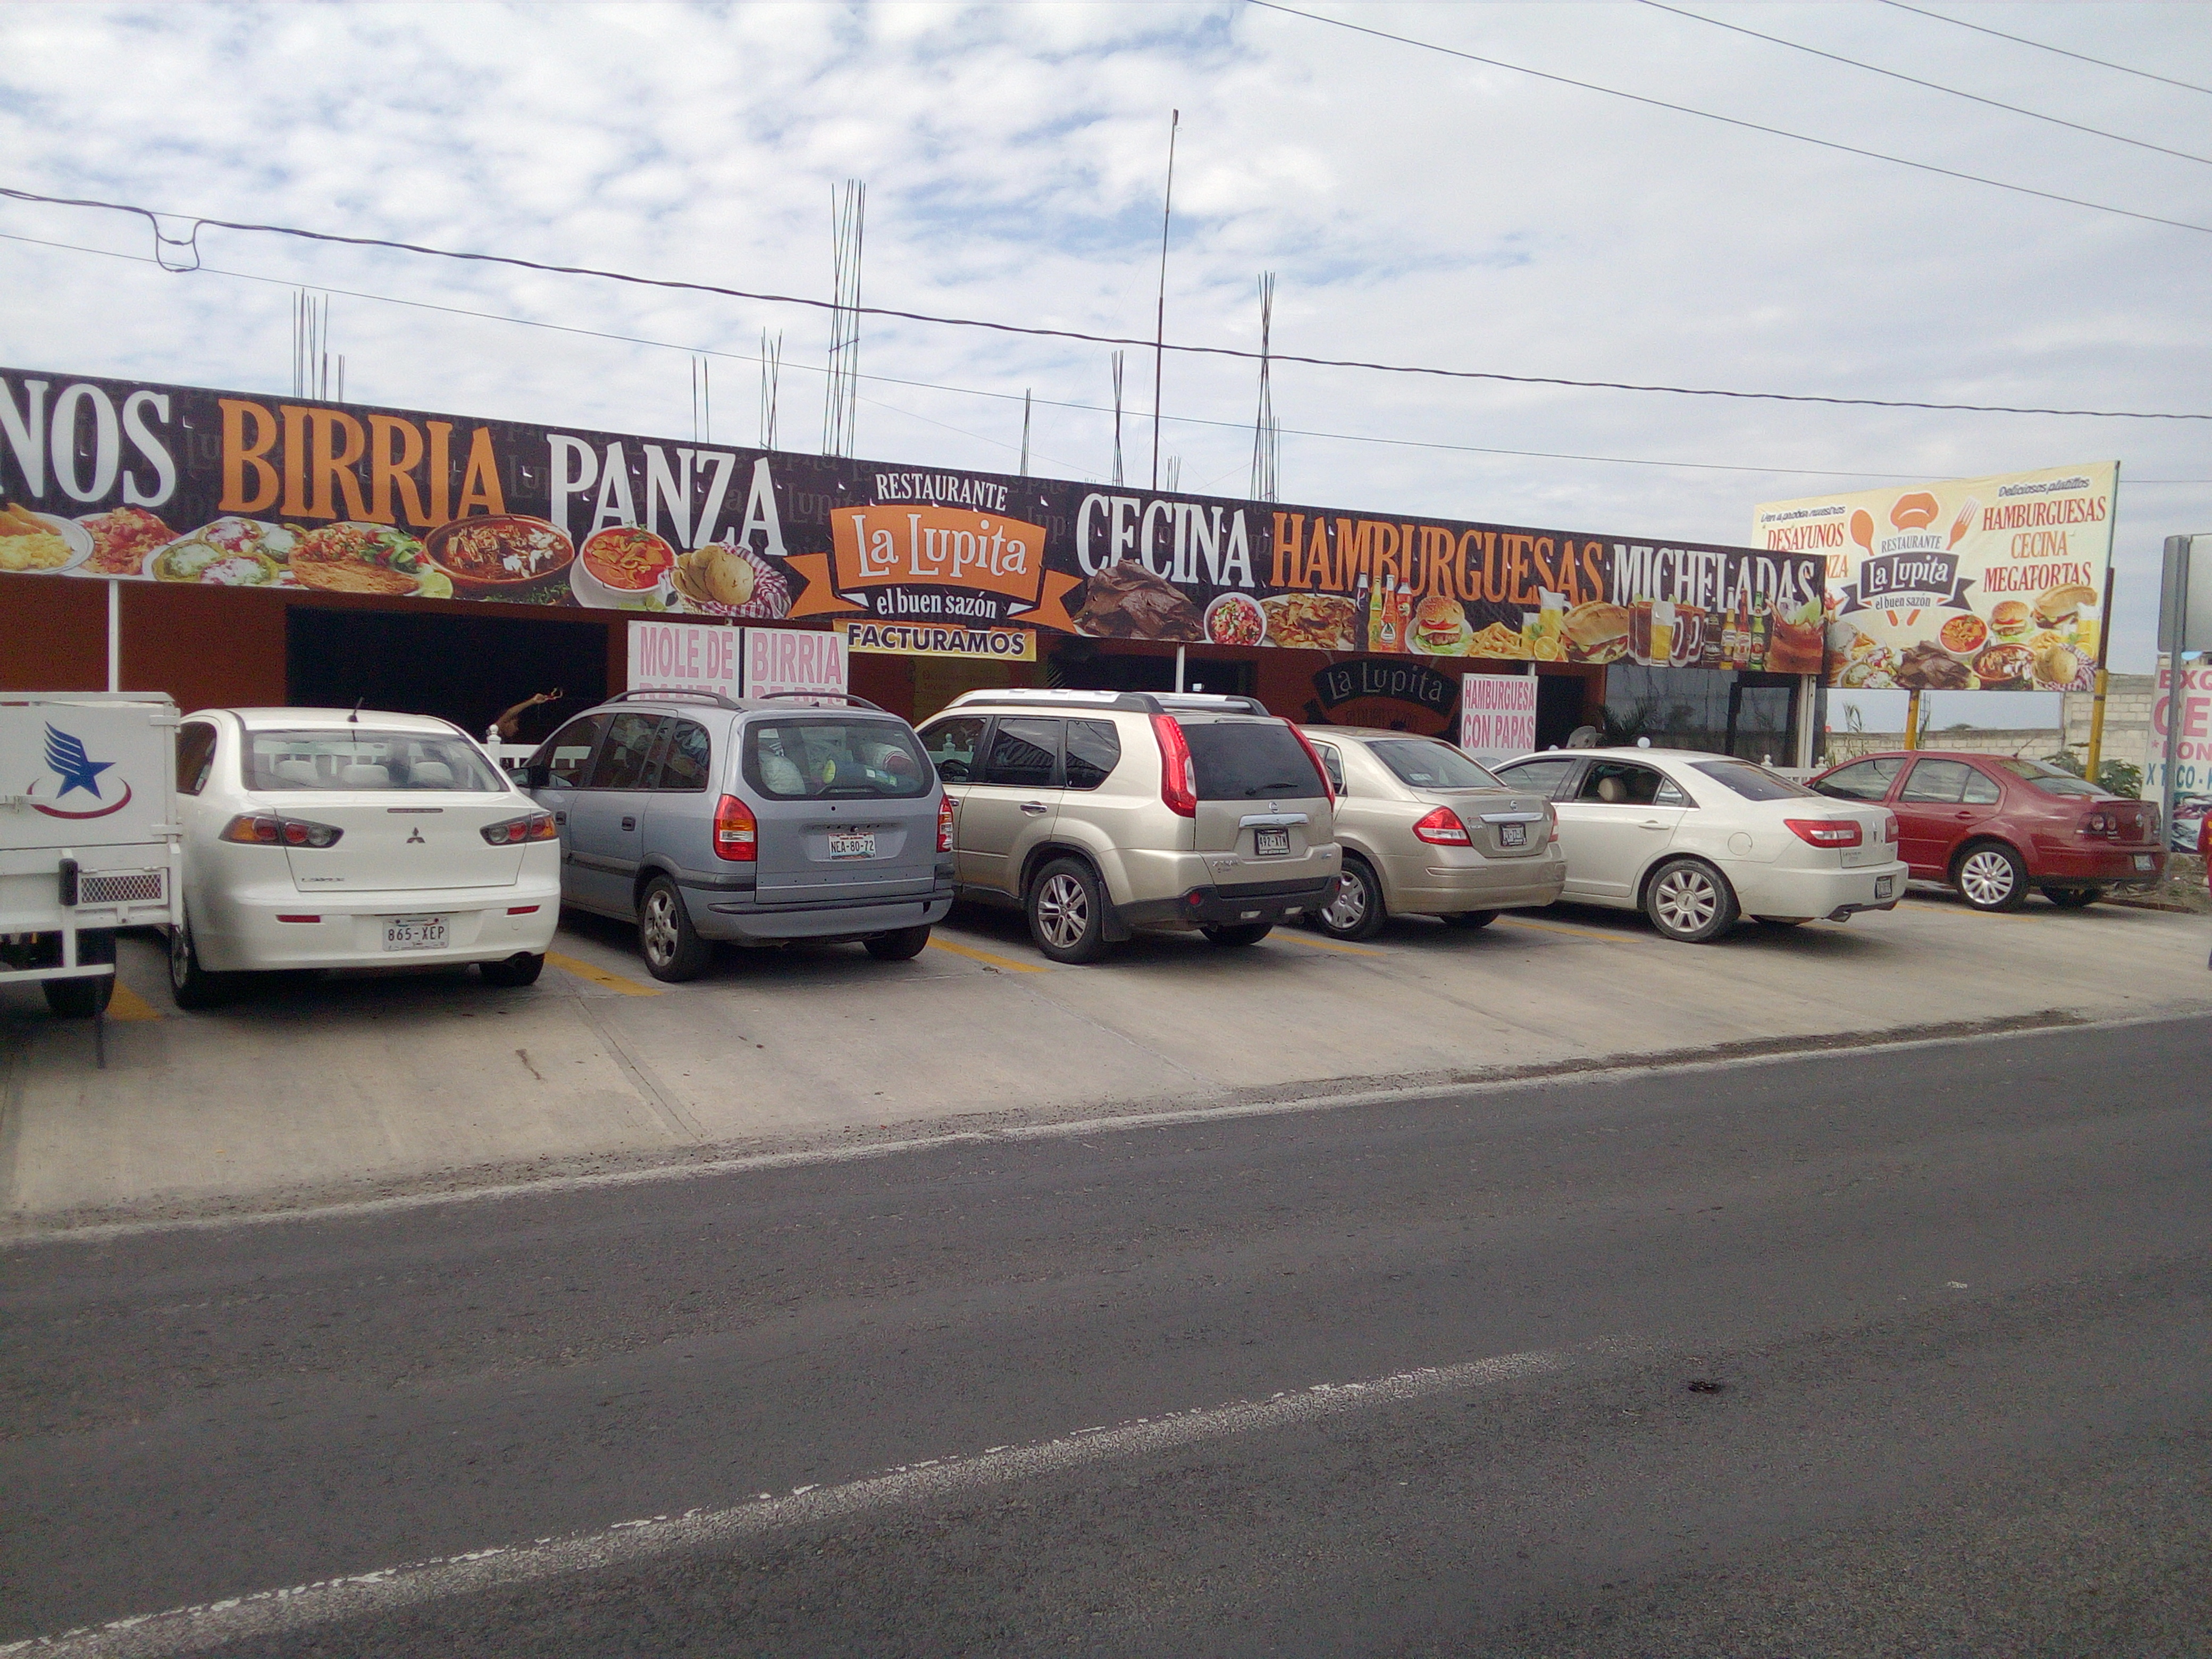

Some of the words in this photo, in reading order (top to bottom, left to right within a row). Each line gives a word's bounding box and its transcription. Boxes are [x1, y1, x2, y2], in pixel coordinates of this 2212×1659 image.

[218, 398, 506, 528] BIRRIA
[547, 434, 788, 556] PANZA
[875, 473, 1008, 512] RESTAURANTE
[1982, 496, 2106, 531] HAMBURGUESAS
[851, 514, 899, 577] La
[907, 514, 1027, 578] Lupita
[1076, 493, 1255, 588] CECINA
[1767, 523, 1844, 552] DESAYUNOS
[1881, 535, 1942, 554] RESTAURANTE
[2011, 531, 2068, 559] CECINA
[1270, 512, 1604, 605] HAMBURGUESAS
[1869, 562, 1888, 593] La
[1890, 555, 1948, 589] Lupita
[1613, 544, 1814, 616] MICHELADAS
[1983, 562, 2091, 592] MEGATORTAS
[877, 589, 894, 615] el
[896, 587, 943, 614] buen
[945, 591, 996, 619] sazón
[1875, 597, 1883, 610] el
[1884, 596, 1904, 608] buen
[640, 626, 699, 678] MOLE
[707, 630, 733, 680] DE
[848, 624, 1025, 656] FACTURAMOS
[752, 632, 842, 684] BIRRIA
[1327, 671, 1353, 700] La
[1362, 662, 1442, 702] Lupita
[1465, 680, 1534, 710] HAMBURGUESA
[1463, 714, 1491, 748] CON
[1495, 715, 1534, 749] PAPAS
[2160, 764, 2196, 789] TCO
[831, 840, 874, 852] NEA-80-72
[388, 926, 445, 941] 865-XEP
